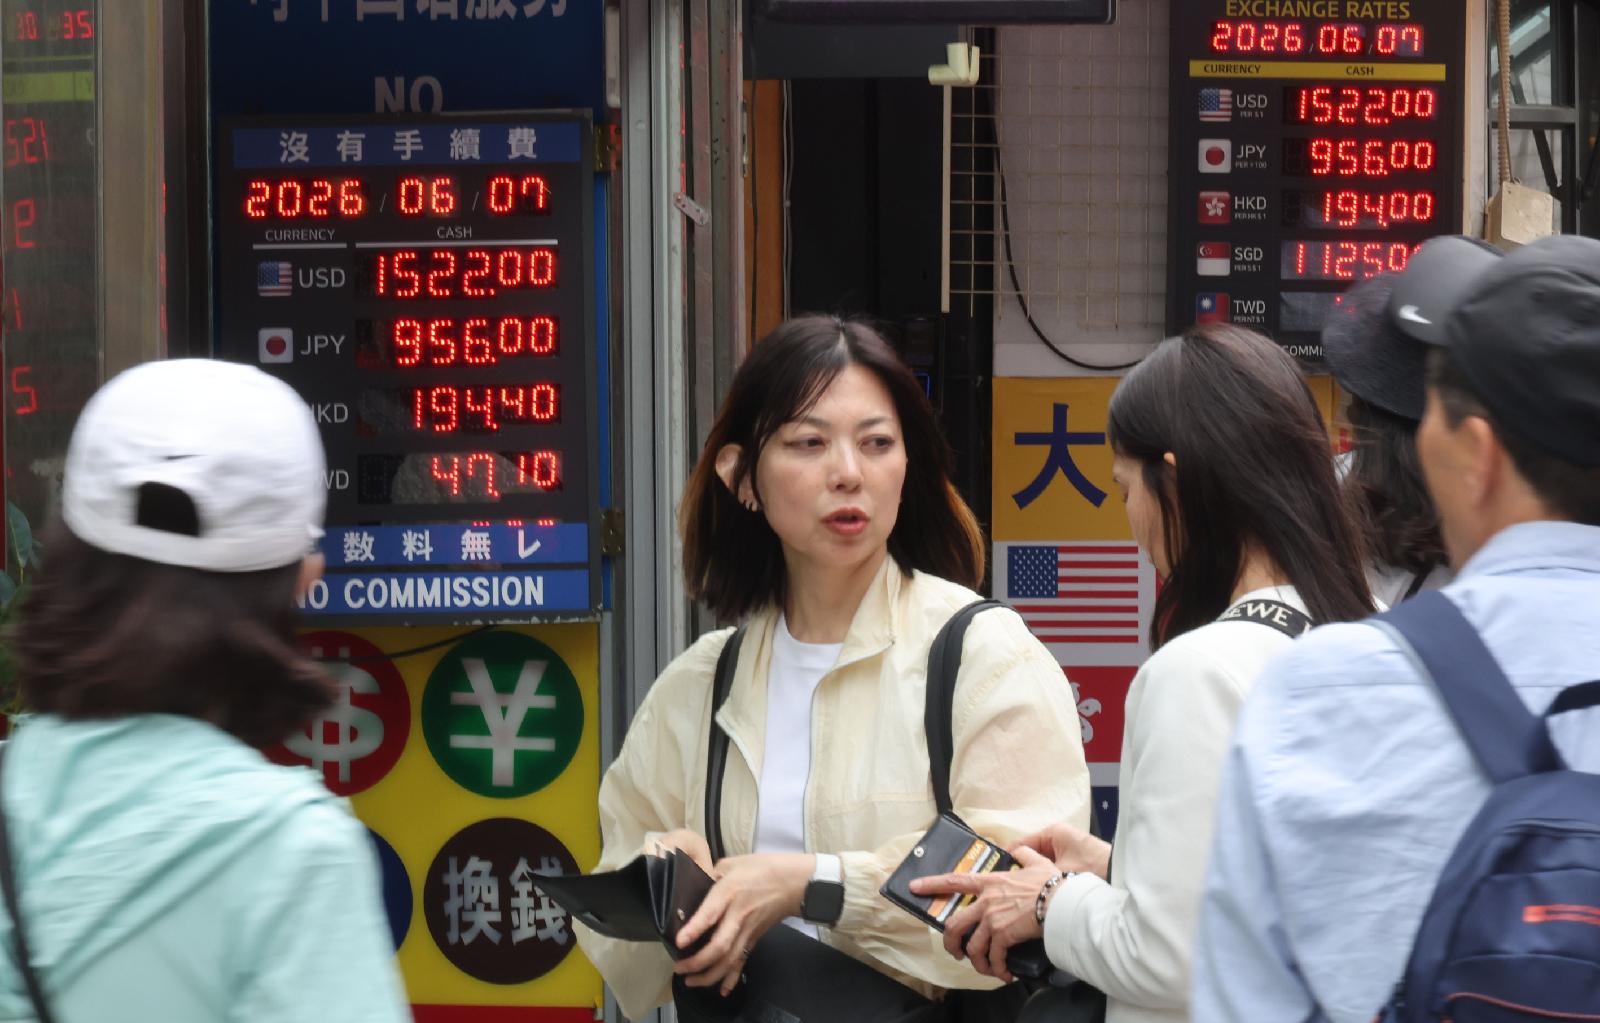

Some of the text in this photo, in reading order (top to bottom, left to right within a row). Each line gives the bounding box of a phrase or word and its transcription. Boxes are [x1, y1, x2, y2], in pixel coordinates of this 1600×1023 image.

[1225, 0, 1411, 20] EXCHANGE RATES
[1203, 64, 1375, 77] CURRENCY CASH
[373, 76, 444, 114] NO
[1236, 94, 1268, 108] USD
[1299, 87, 1435, 125] 1522.00
[279, 128, 538, 164] 沒有手續費
[1236, 145, 1266, 159] JPY
[1310, 139, 1434, 176] 956.00
[245, 180, 365, 217] 2026
[399, 178, 455, 214] 06
[488, 177, 547, 212] 07
[1234, 196, 1267, 210] HKD
[1323, 190, 1433, 228] 194.00
[265, 226, 473, 242] CURRENCY CASH
[1234, 247, 1263, 261] SGD
[298, 268, 346, 288] USD
[378, 249, 555, 297] 1522.00
[1233, 300, 1266, 314] TWD
[300, 335, 346, 355] JPY
[393, 317, 556, 365] 956.00
[1281, 344, 1324, 357] OMMI
[415, 384, 556, 432] 194.40
[1011, 402, 1108, 511] 大
[343, 575, 545, 608] COMMISSION
[442, 855, 571, 946] 換錢
